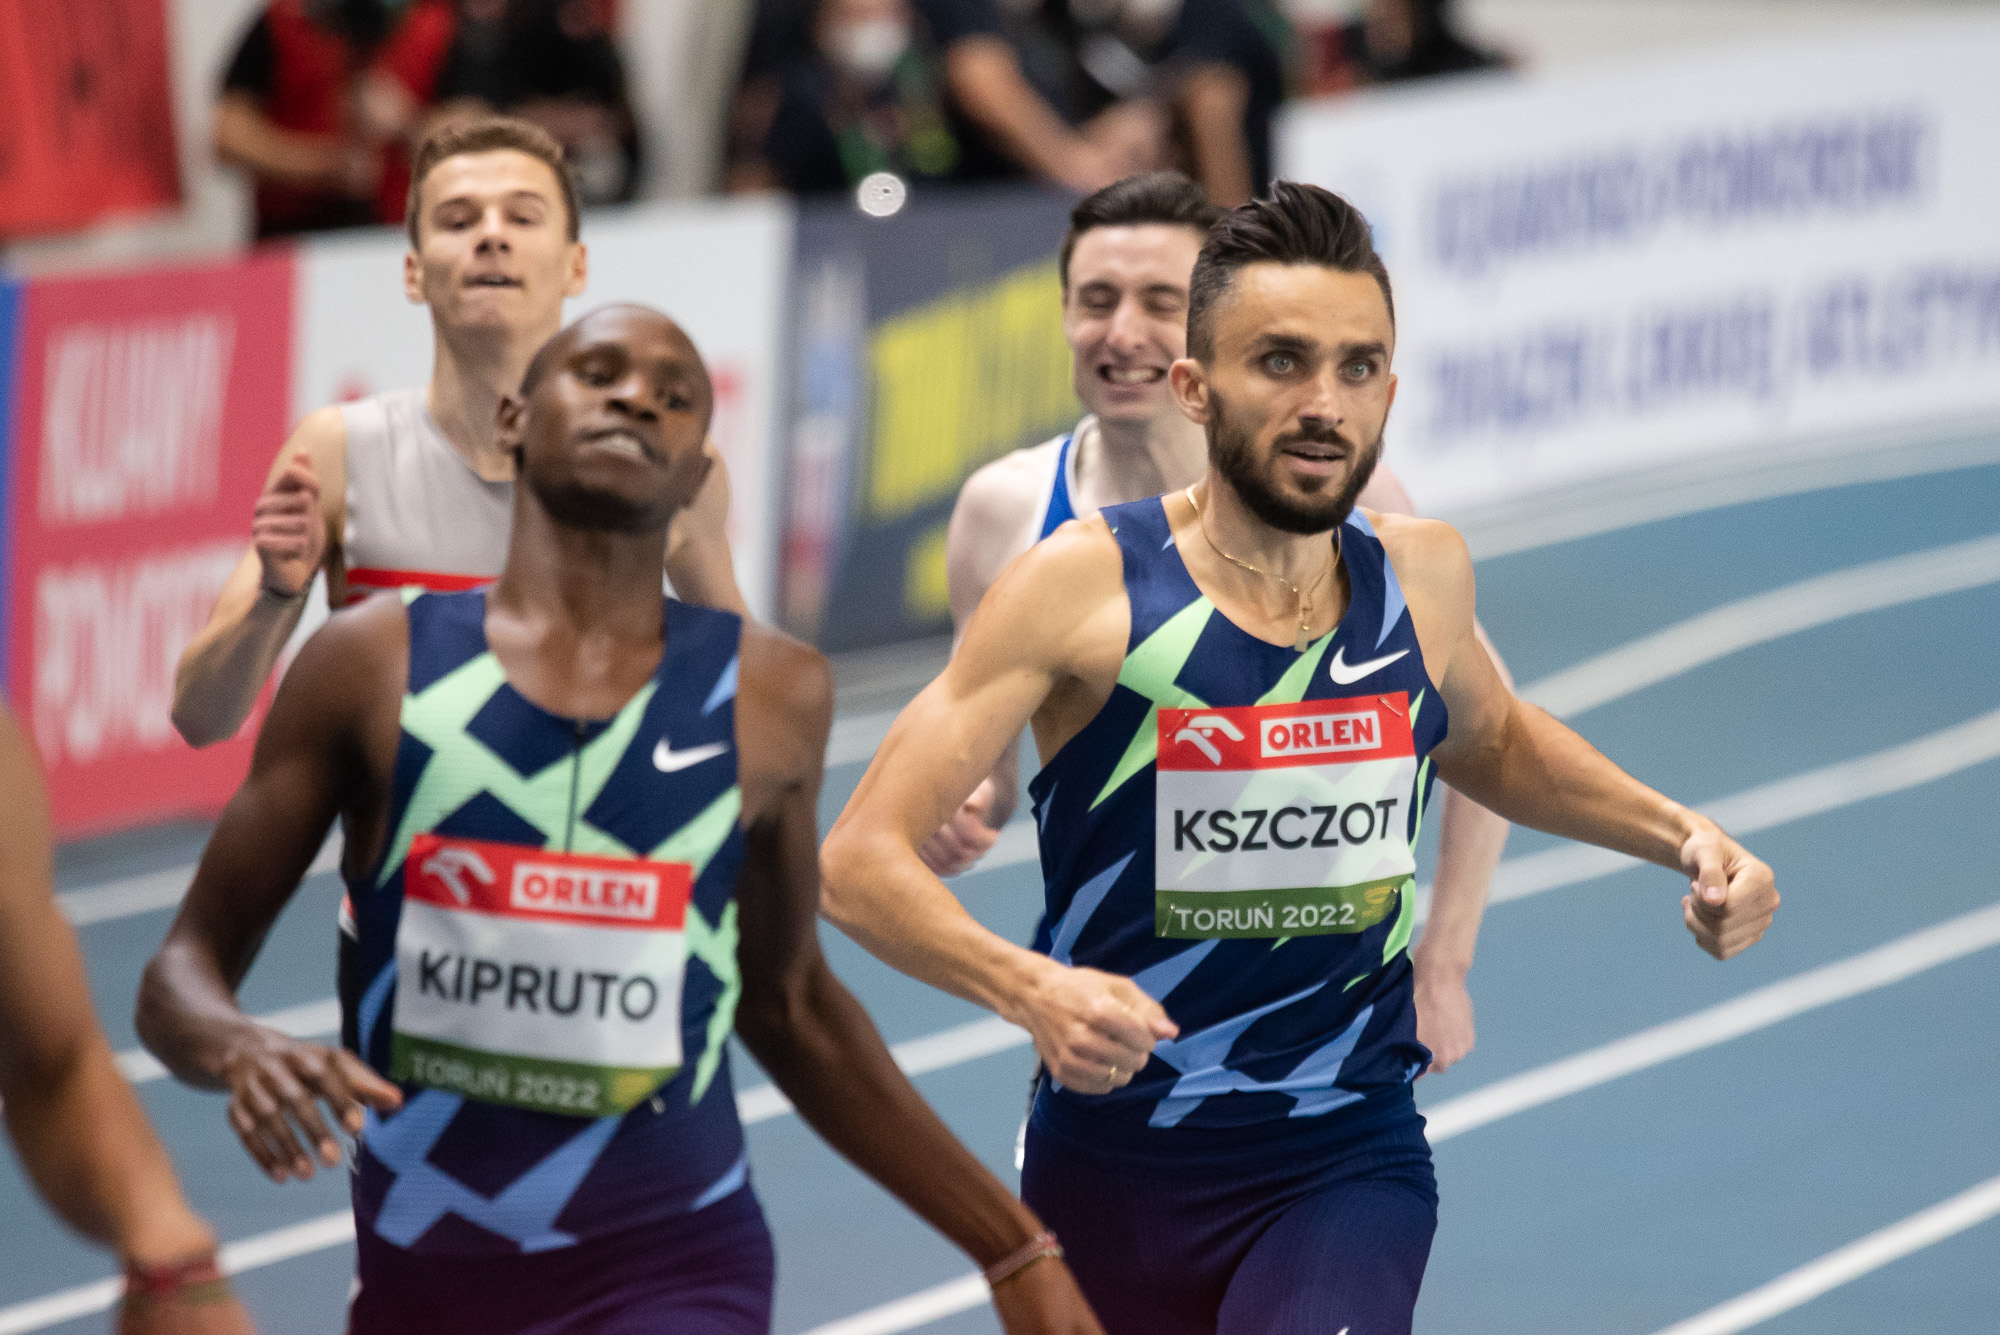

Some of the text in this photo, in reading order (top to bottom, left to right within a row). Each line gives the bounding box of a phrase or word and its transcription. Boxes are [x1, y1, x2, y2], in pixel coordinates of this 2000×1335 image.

[1268, 717, 1374, 750] ORLEN
[1174, 798, 1398, 853] KSZCZOT
[522, 872, 647, 907] ORLEN
[1175, 901, 1356, 931] TORUŃ 2022
[418, 950, 658, 1021] KIPRUTO
[514, 1071, 599, 1109] 2022
